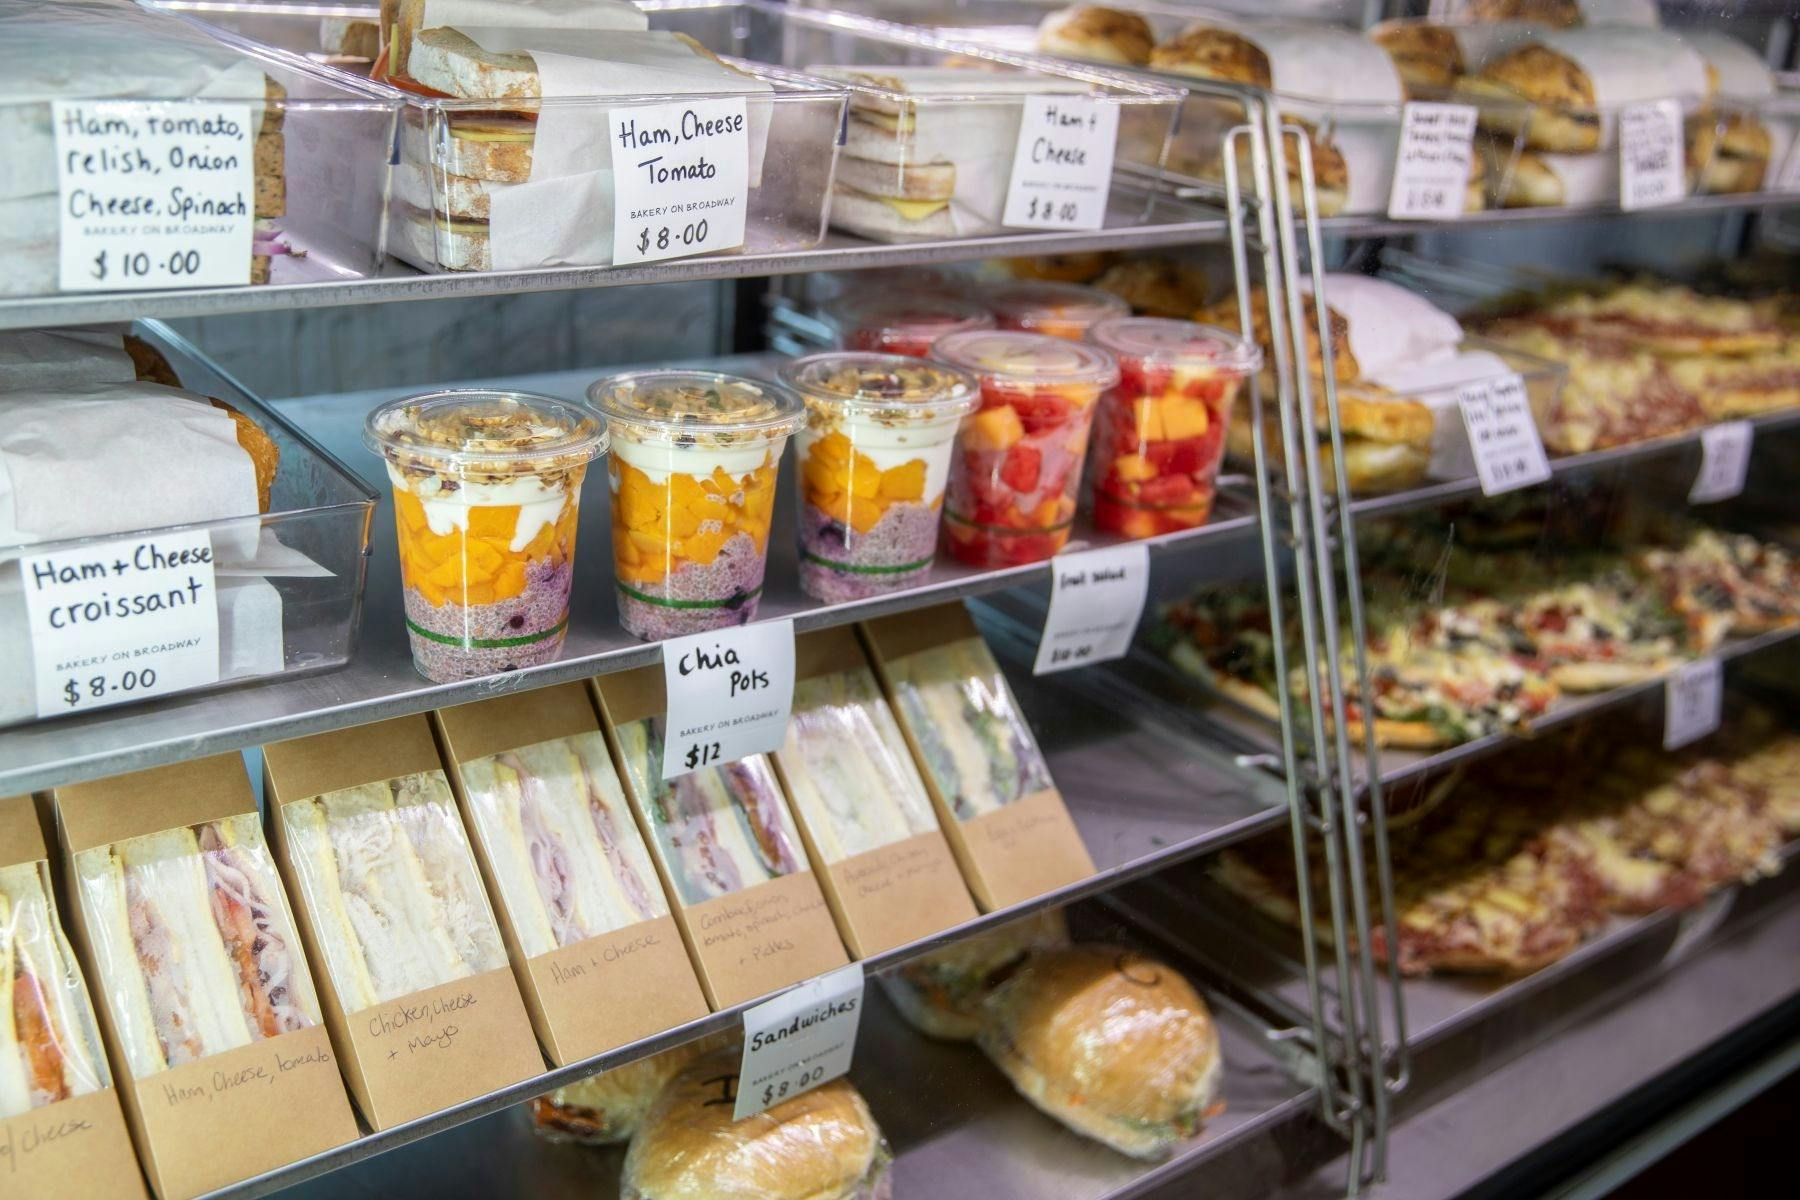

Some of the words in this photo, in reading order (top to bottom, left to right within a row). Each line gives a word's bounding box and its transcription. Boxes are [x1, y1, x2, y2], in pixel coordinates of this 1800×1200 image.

[63, 108, 138, 138] Ham,
[619, 119, 678, 149] Ham,
[682, 110, 743, 140] Cheese
[1045, 105, 1083, 126] Ham
[68, 146, 160, 174] relish,
[169, 146, 238, 169] Onion
[1032, 137, 1086, 165] Cheese
[638, 156, 716, 184] Tomato
[69, 188, 161, 218] Cheese,
[167, 187, 246, 220] Spinach
[630, 205, 668, 219] BAKERY
[671, 204, 684, 213] ON
[686, 197, 735, 212] BROADWAY
[84, 226, 137, 236] BAKERY
[142, 226, 160, 235] ON
[165, 224, 234, 235] BROADWAY
[32, 560, 106, 590] Ham
[113, 560, 129, 576] +
[134, 543, 214, 571] Cheese
[50, 576, 202, 628] croissant
[56, 655, 107, 671] BAKERY
[112, 651, 130, 661] ON
[134, 637, 201, 658] BROADWAY
[680, 723, 715, 738] BAKERY
[718, 720, 730, 729] ON
[732, 709, 779, 726] BROADWAY
[685, 742, 721, 769] $12
[551, 963, 586, 986] Ham
[751, 998, 857, 1051] Sandwiches
[387, 1049, 398, 1060] +
[408, 1025, 459, 1054] Mayo
